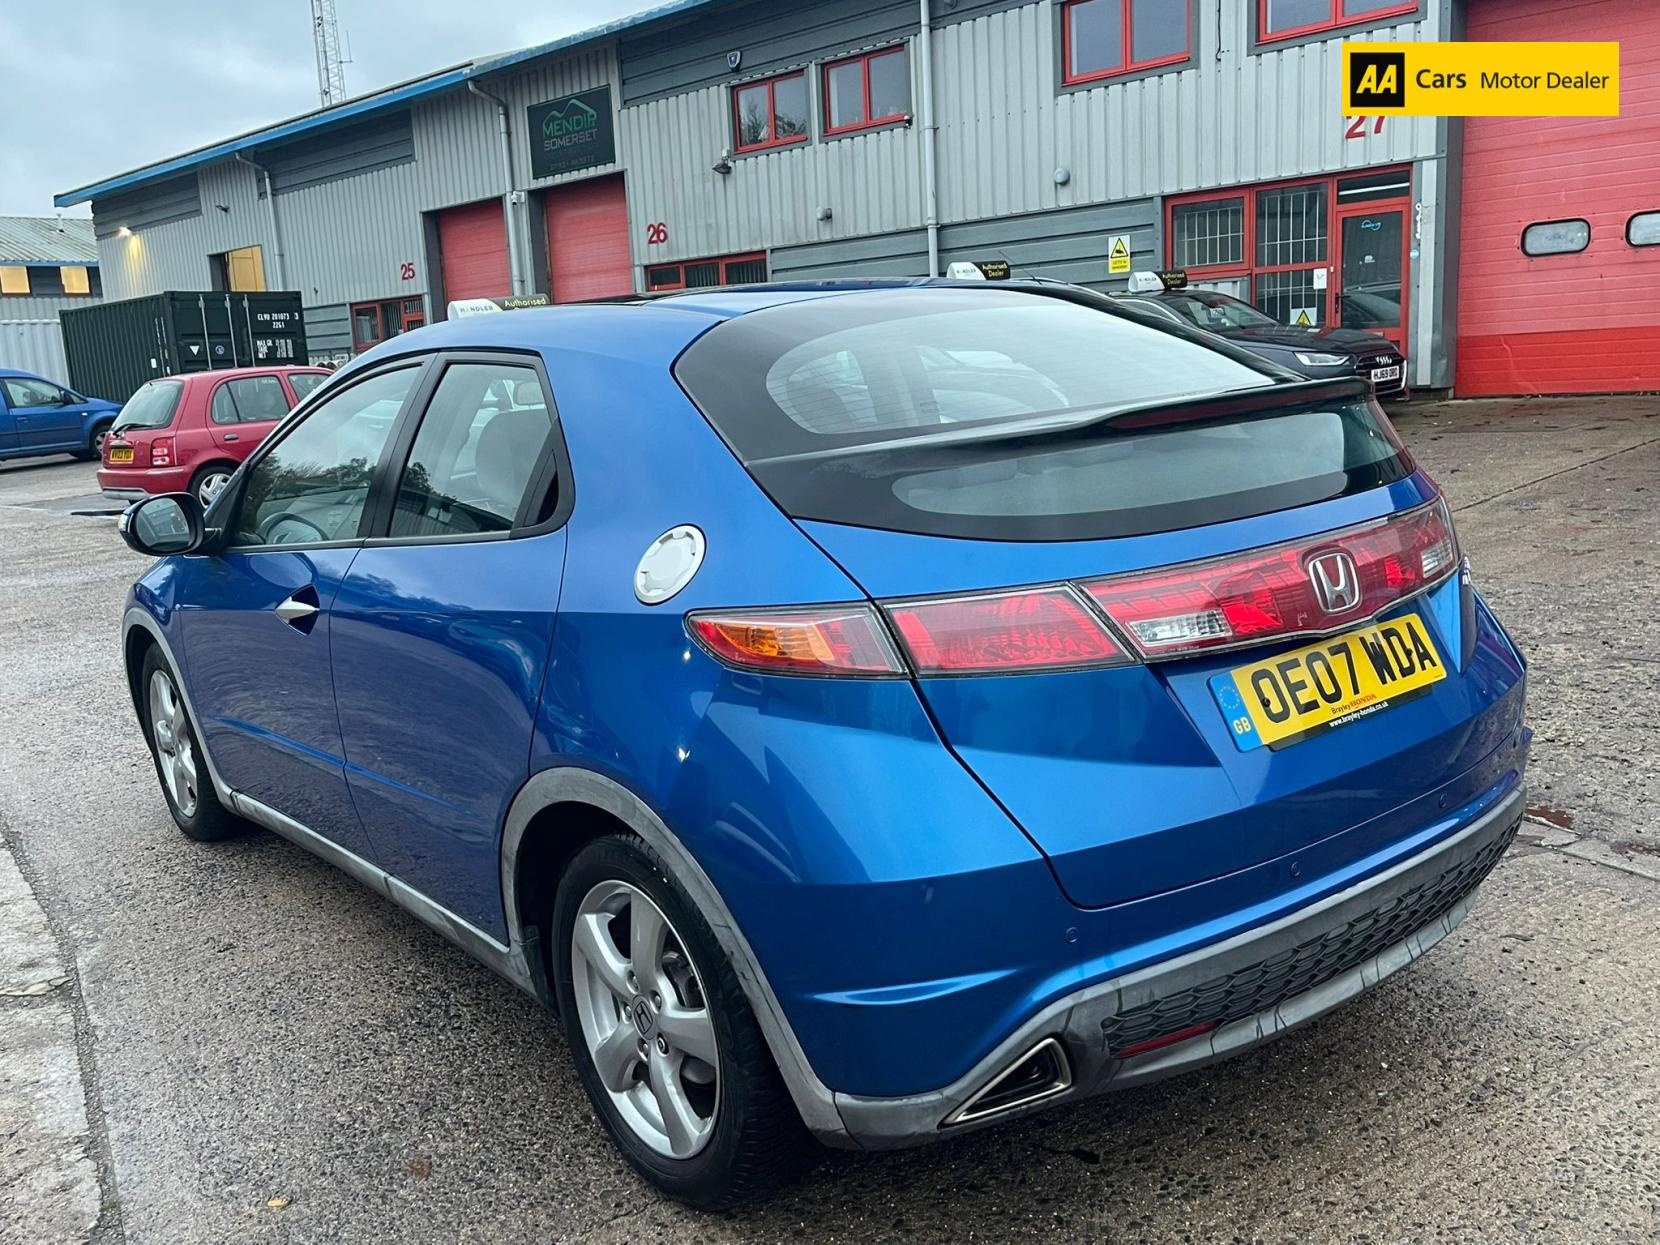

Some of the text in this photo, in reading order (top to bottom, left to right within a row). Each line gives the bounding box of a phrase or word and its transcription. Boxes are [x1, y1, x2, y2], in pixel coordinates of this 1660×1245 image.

[543, 111, 597, 137] MENDIP
[543, 129, 598, 151] SOMERSET
[647, 222, 668, 244] 26
[401, 263, 415, 280] 25
[504, 297, 547, 307] Authorised
[1251, 622, 1437, 723] OE07 WDA
[1350, 693, 1377, 708] HONDA
[1329, 701, 1389, 727] www.brayley-honda.co.uk
[1233, 716, 1252, 735] GB
